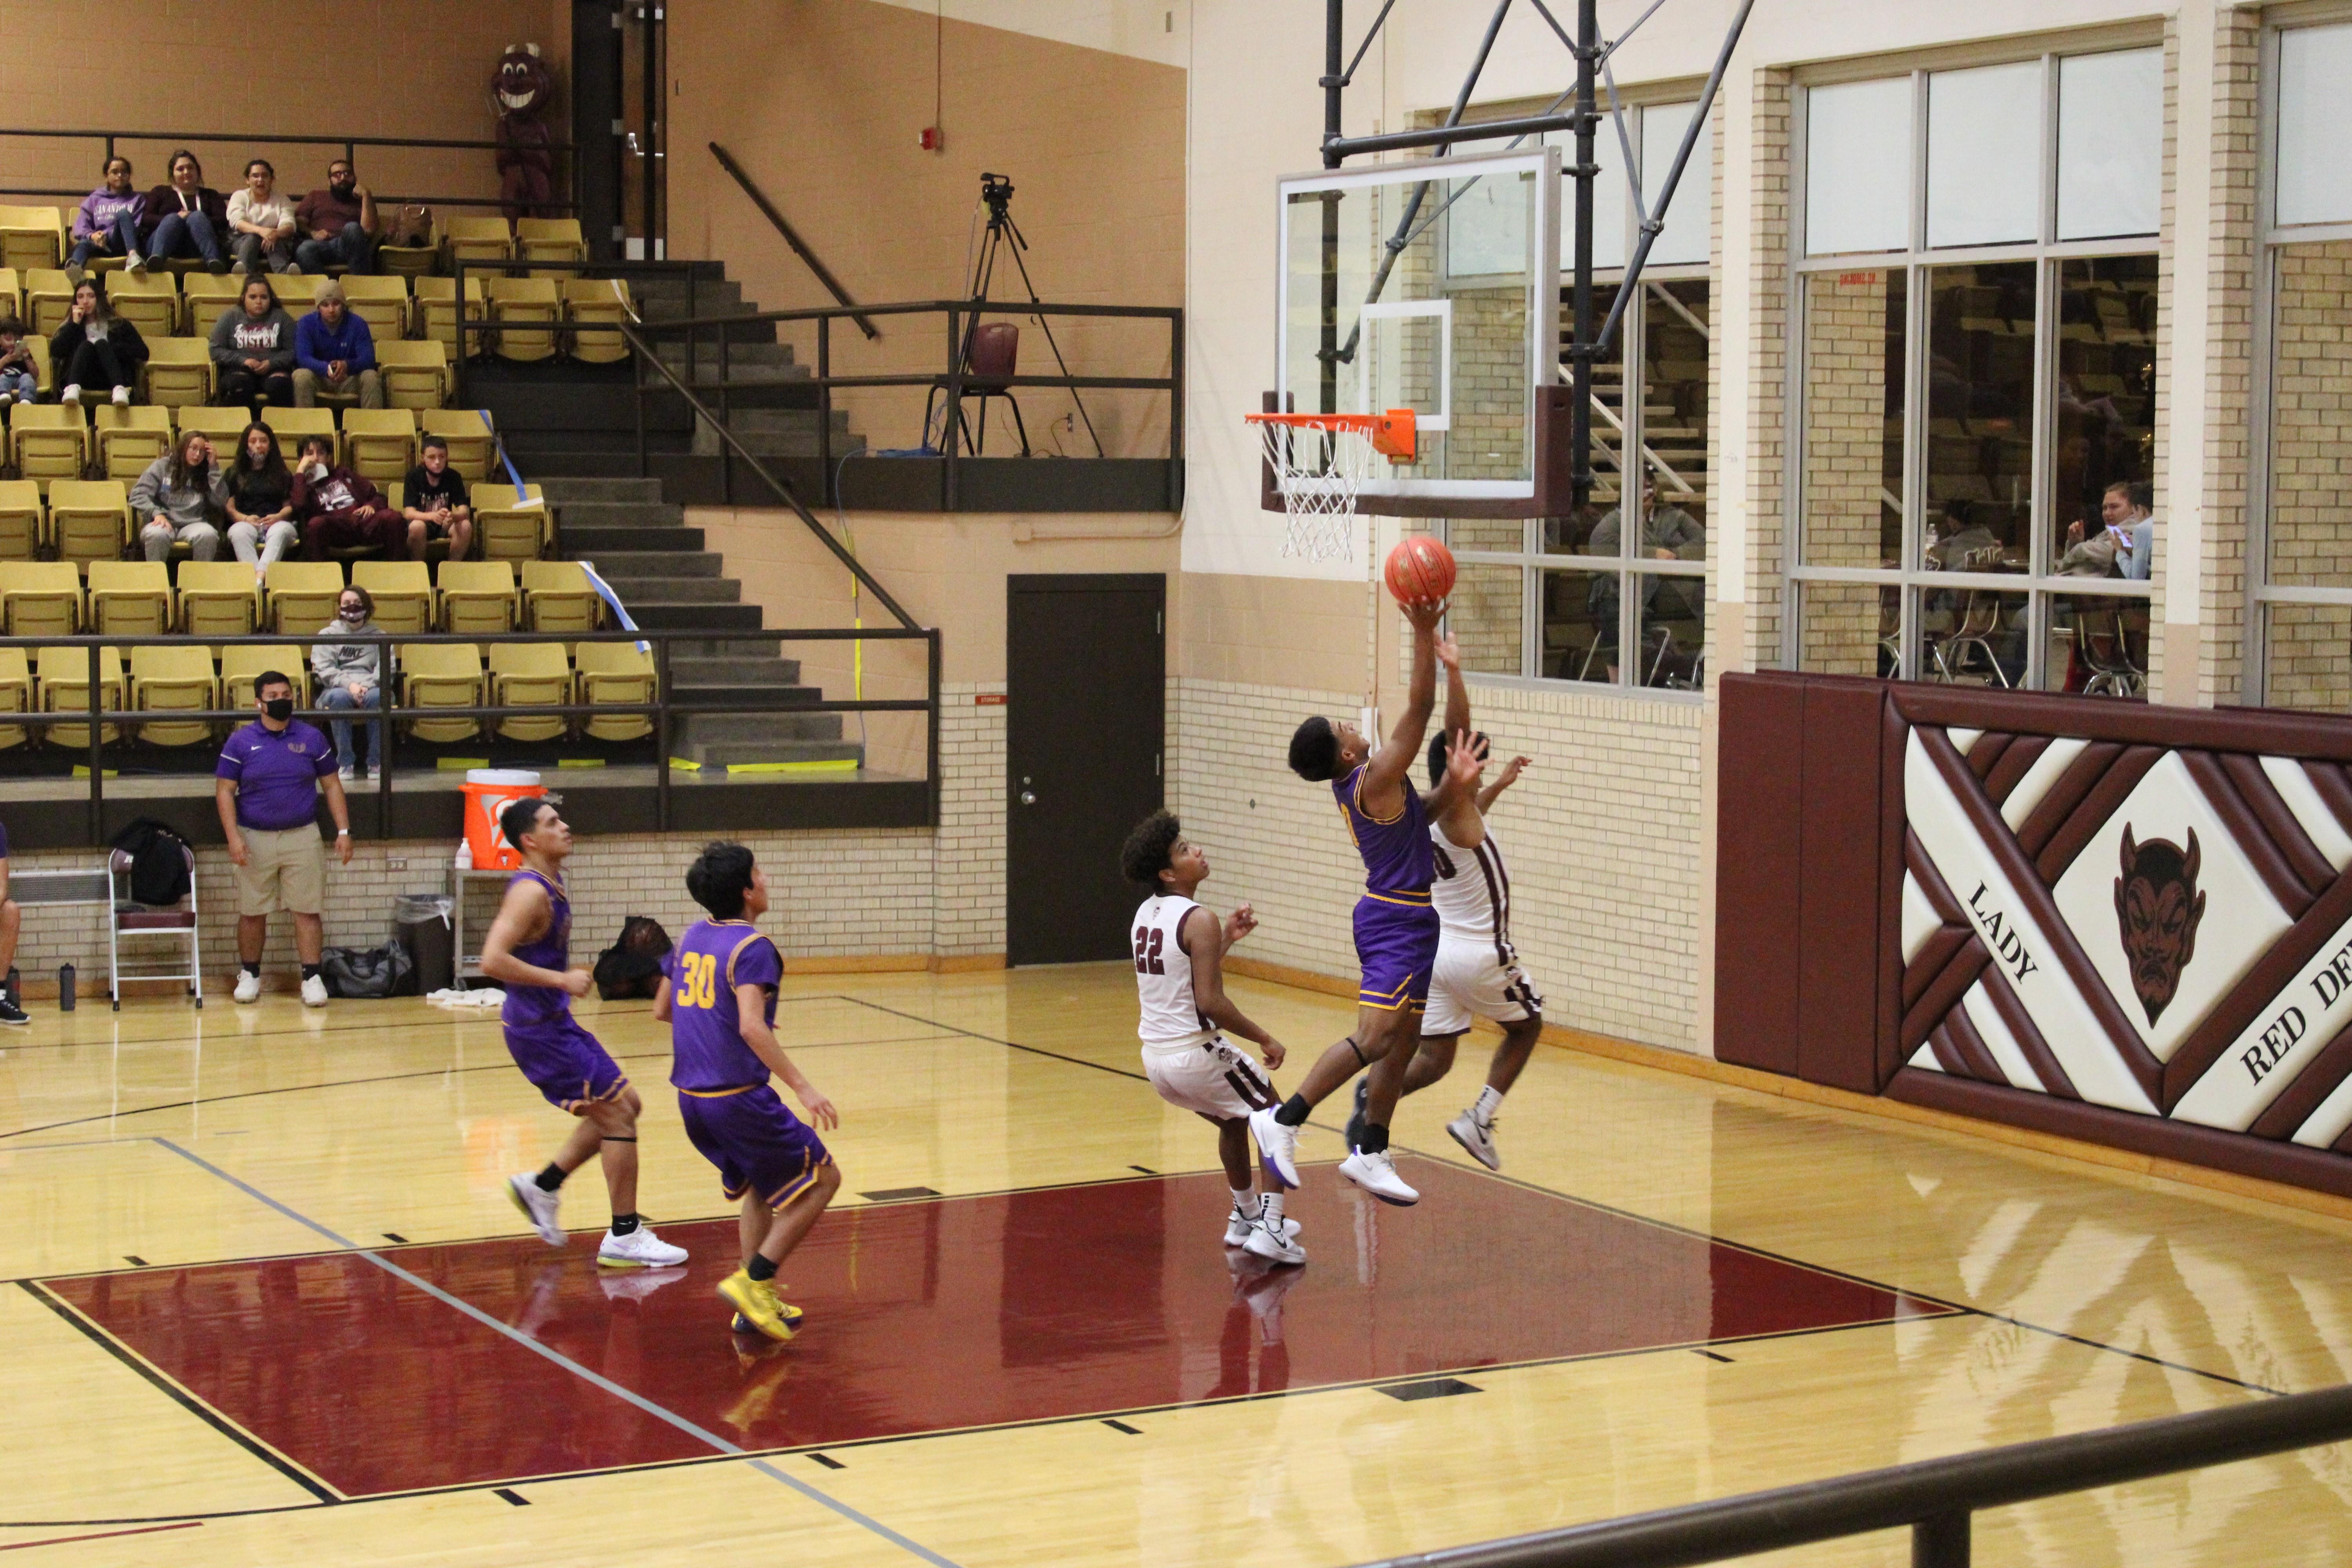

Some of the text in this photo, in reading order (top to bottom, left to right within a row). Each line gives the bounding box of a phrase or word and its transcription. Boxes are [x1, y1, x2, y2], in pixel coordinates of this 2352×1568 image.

[94, 204, 105, 216] SAN
[236, 334, 278, 349] SISTER
[1136, 926, 1165, 975] 22
[1968, 880, 2038, 984] LADY
[677, 951, 717, 1009] 30
[2240, 1005, 2306, 1086] RED
